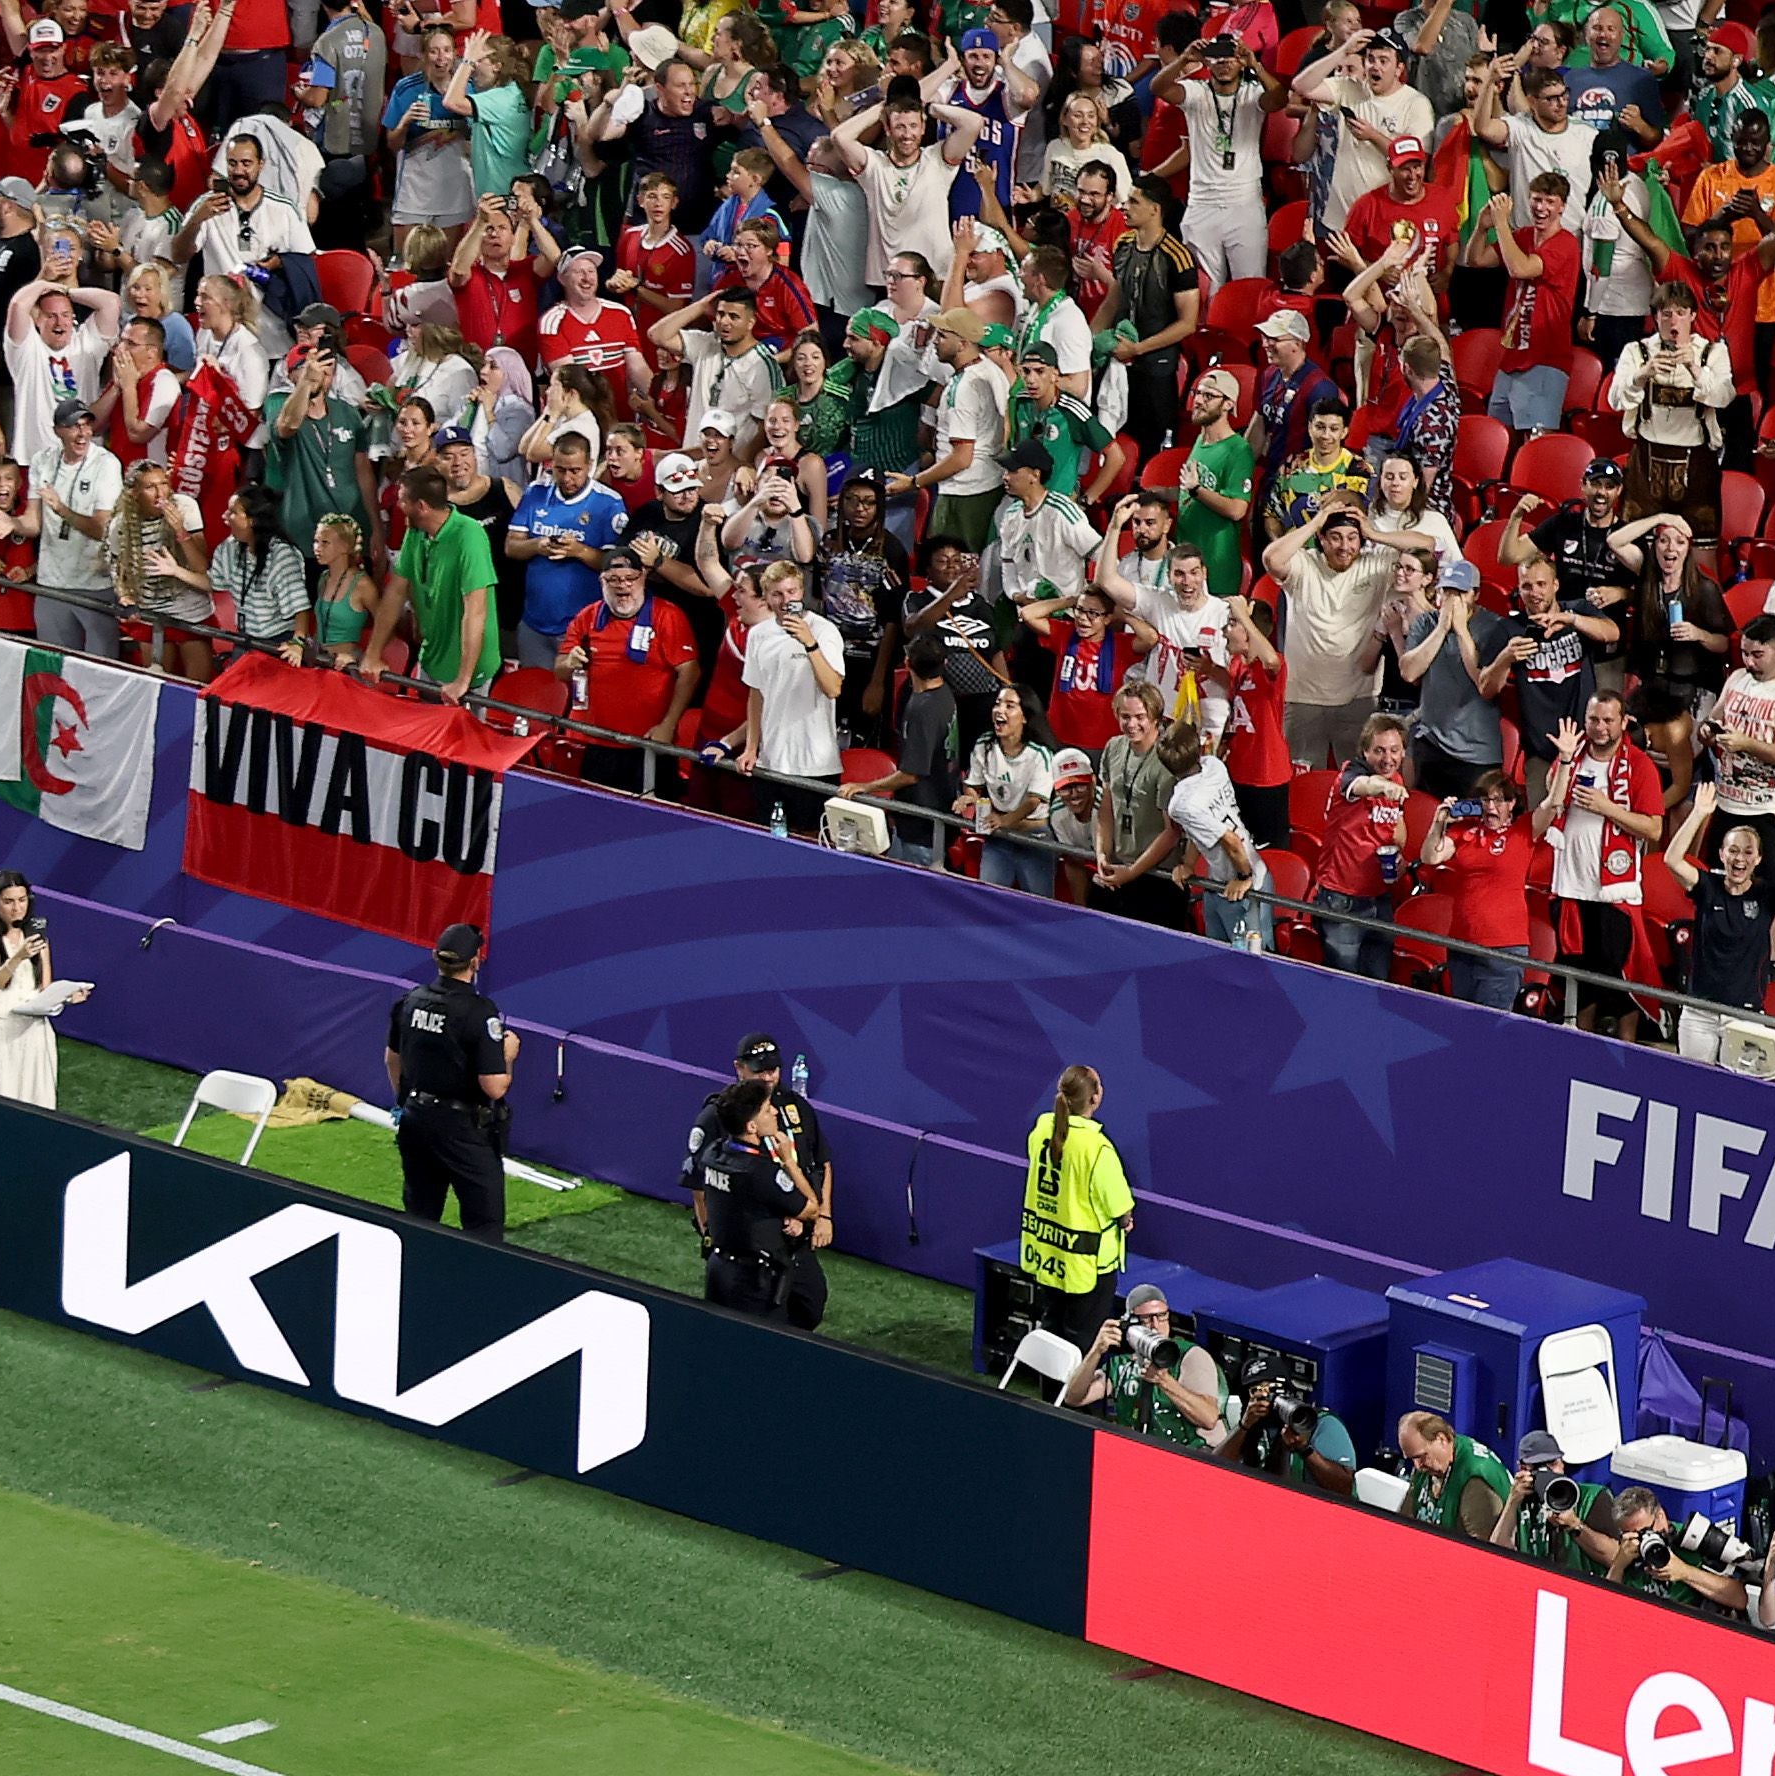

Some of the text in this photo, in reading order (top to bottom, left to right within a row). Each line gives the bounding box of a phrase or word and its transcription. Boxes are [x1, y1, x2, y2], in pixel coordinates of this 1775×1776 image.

[532, 522, 586, 543] Emirates
[1526, 642, 1583, 671] SOCCER
[202, 695, 495, 875] VIVA CU
[411, 1008, 447, 1034] POLICE
[703, 1166, 732, 1193] POLICE
[61, 1150, 651, 1474] KIA
